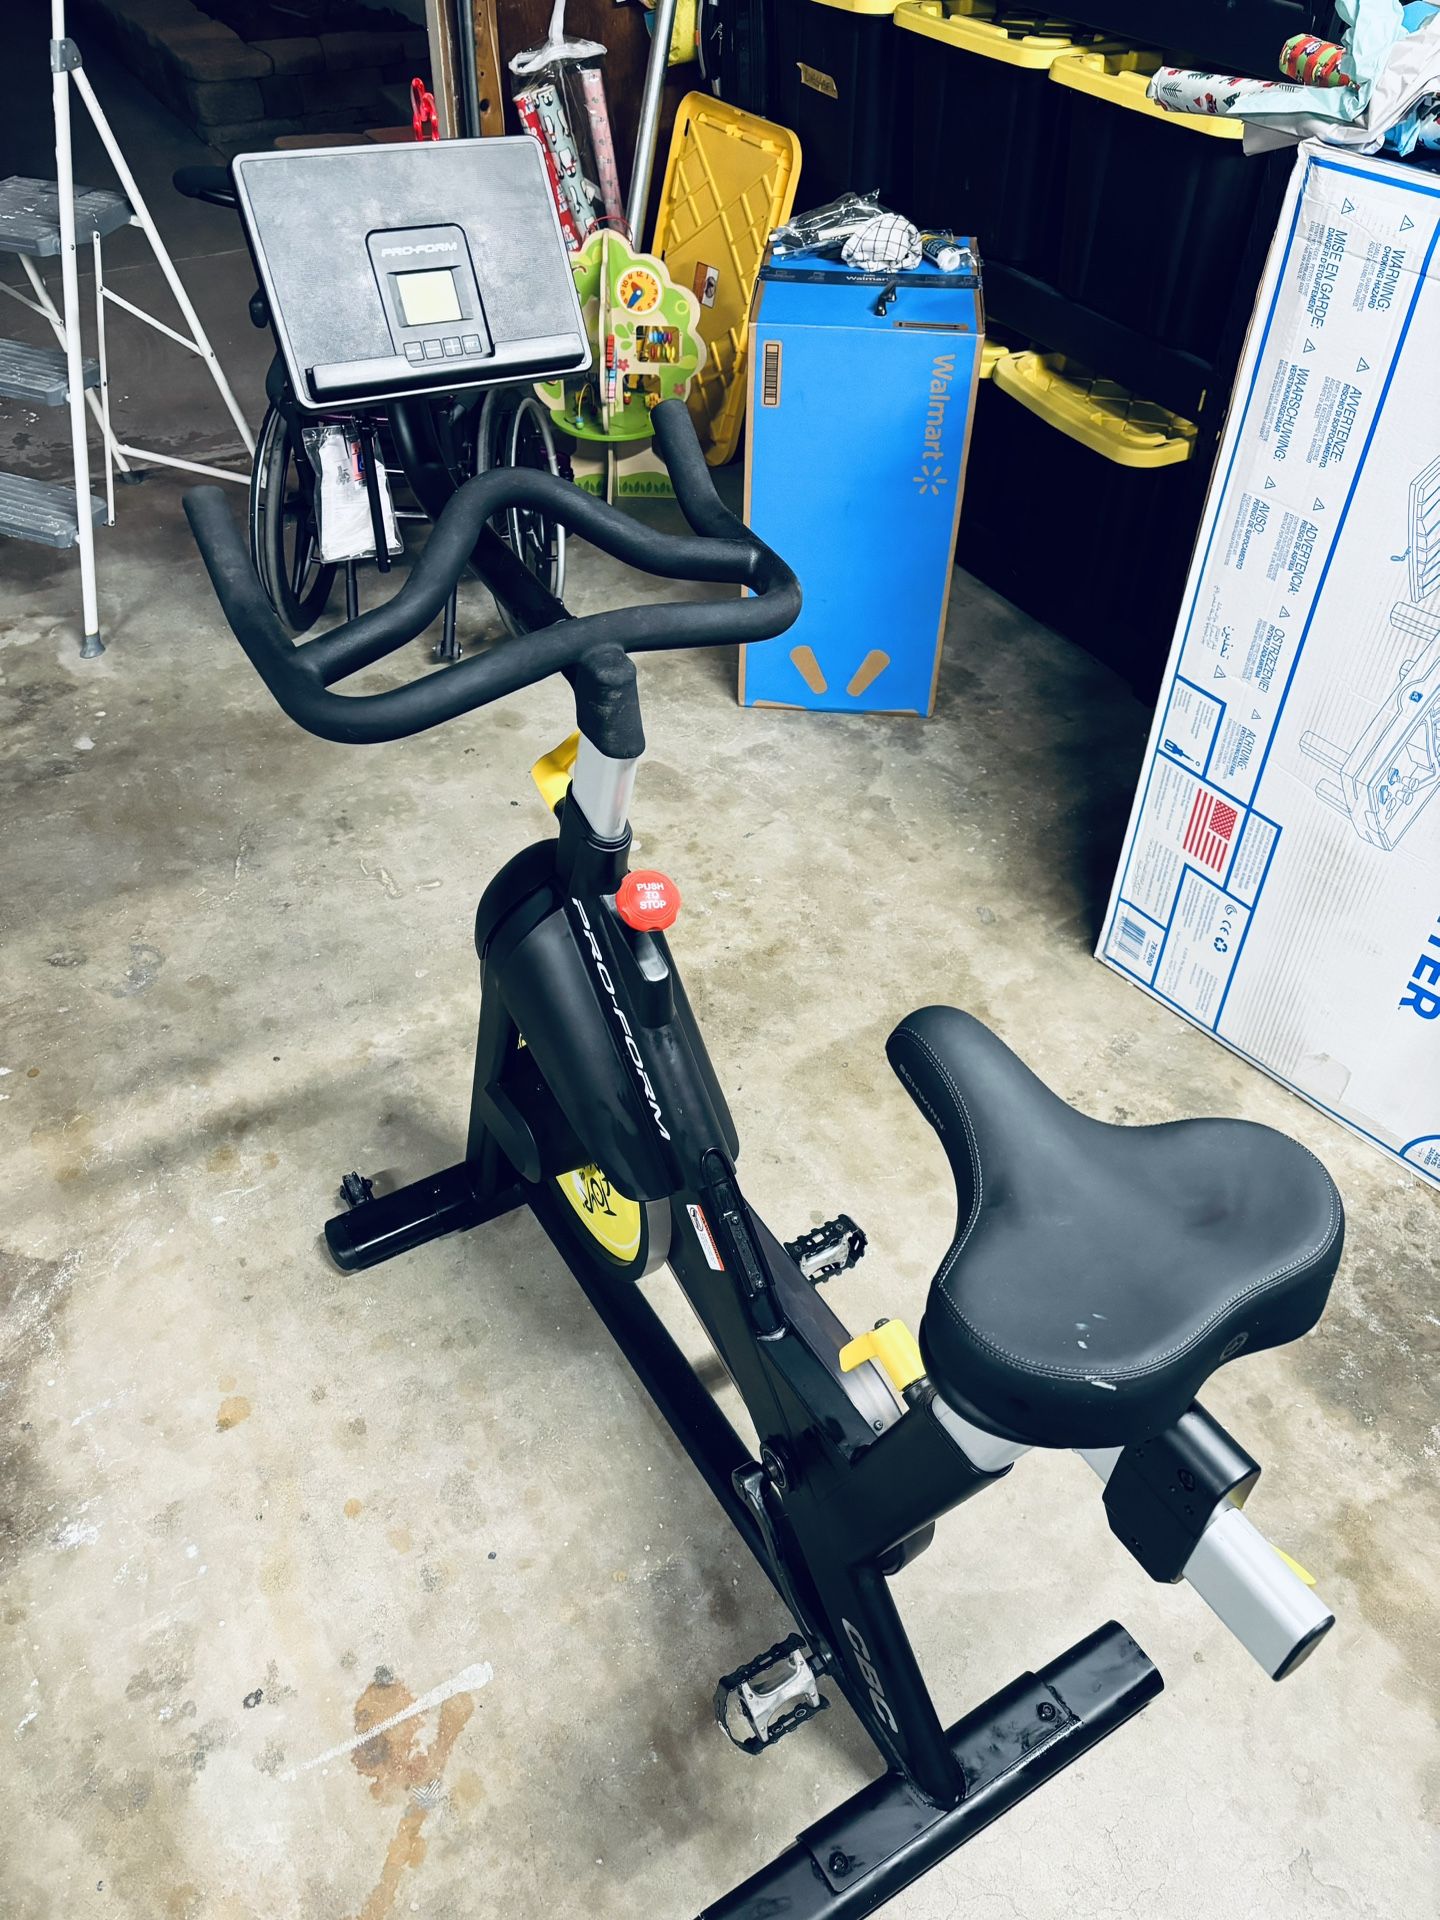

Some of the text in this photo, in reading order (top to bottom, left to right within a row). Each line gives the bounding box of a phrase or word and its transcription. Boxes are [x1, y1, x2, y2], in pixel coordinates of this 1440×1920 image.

[381, 242, 458, 257] PRO-FORM
[1321, 227, 1335, 256] DANGER
[1329, 229, 1348, 261] MISE
[1323, 262, 1338, 281] EN
[1366, 245, 1391, 309] CHOKING HAZARD
[1375, 247, 1405, 313] WARNING:
[1310, 281, 1333, 329] GARDE:
[922, 353, 956, 460] Walmart
[1271, 366, 1310, 462] WAARSCHUWING:
[1334, 409, 1342, 418] DI
[1336, 383, 1350, 410] RISCHIO
[1317, 417, 1339, 469] SOFFOCAMENTO.
[1328, 385, 1363, 464] AVVERTENZE:
[1246, 519, 1254, 528] DE
[1249, 497, 1260, 519] PERIGO
[1252, 501, 1270, 535] AVISO:
[1235, 528, 1251, 569] SUFOCAMENTO
[1293, 541, 1300, 550] DE
[1295, 519, 1307, 541] RIESGO
[1286, 522, 1319, 596] ADVERTENCIA:
[1257, 628, 1285, 693] OSTRZEŻENIE!
[1236, 729, 1256, 770] ACHTUNG:
[636, 882, 664, 891] PUSH
[639, 900, 666, 910] STOP
[645, 891, 659, 899] TO
[572, 897, 671, 1141] PRO-FORM
[900, 1064, 945, 1130] SCHWINN
[841, 1617, 899, 1734] CBC
